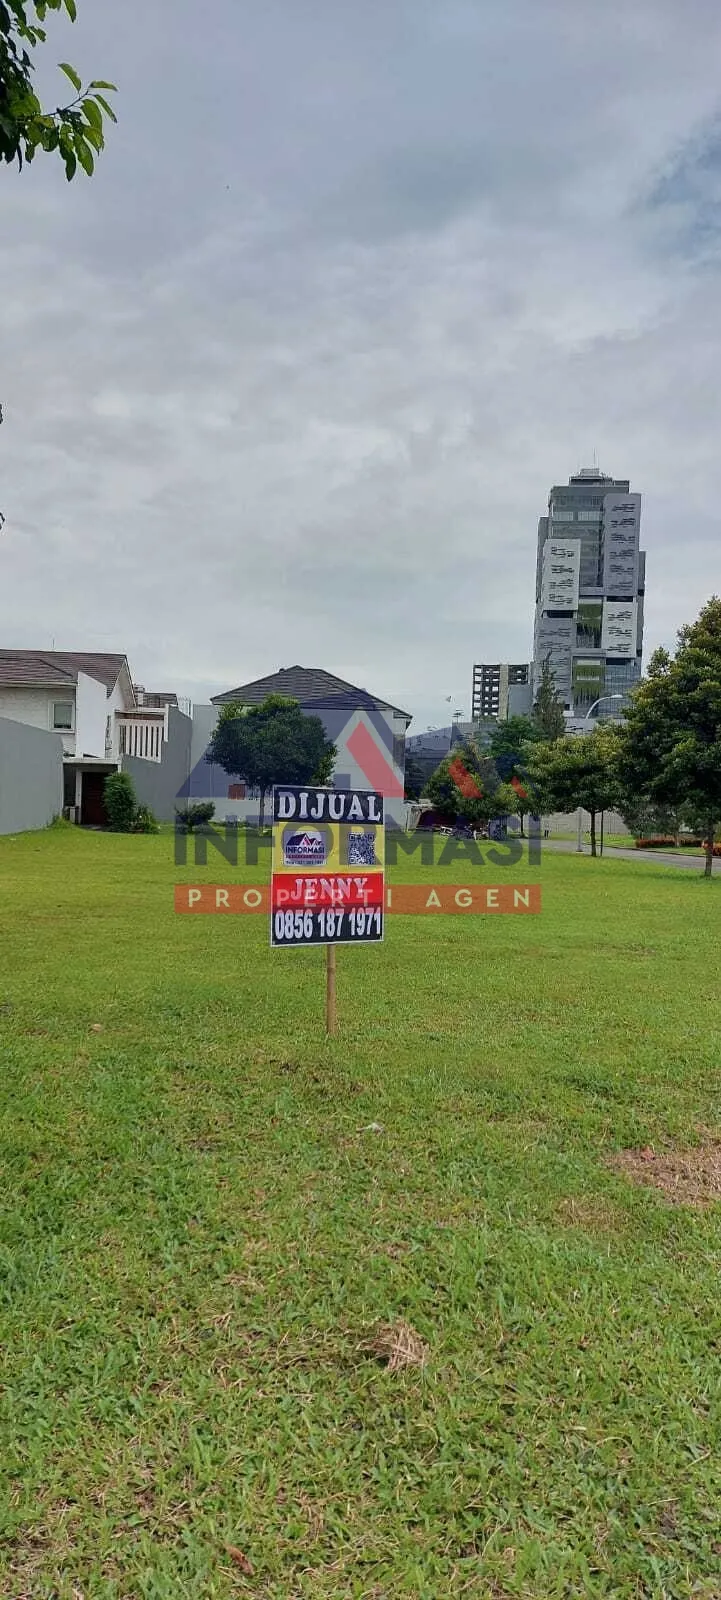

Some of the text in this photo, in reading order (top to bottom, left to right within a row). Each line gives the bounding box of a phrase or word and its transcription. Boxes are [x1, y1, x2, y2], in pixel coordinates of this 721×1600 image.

[278, 791, 381, 822] DIJUAL
[286, 846, 325, 854] INFORMASI
[291, 878, 368, 900] JENNY
[275, 906, 381, 940] 0856 187 1971
